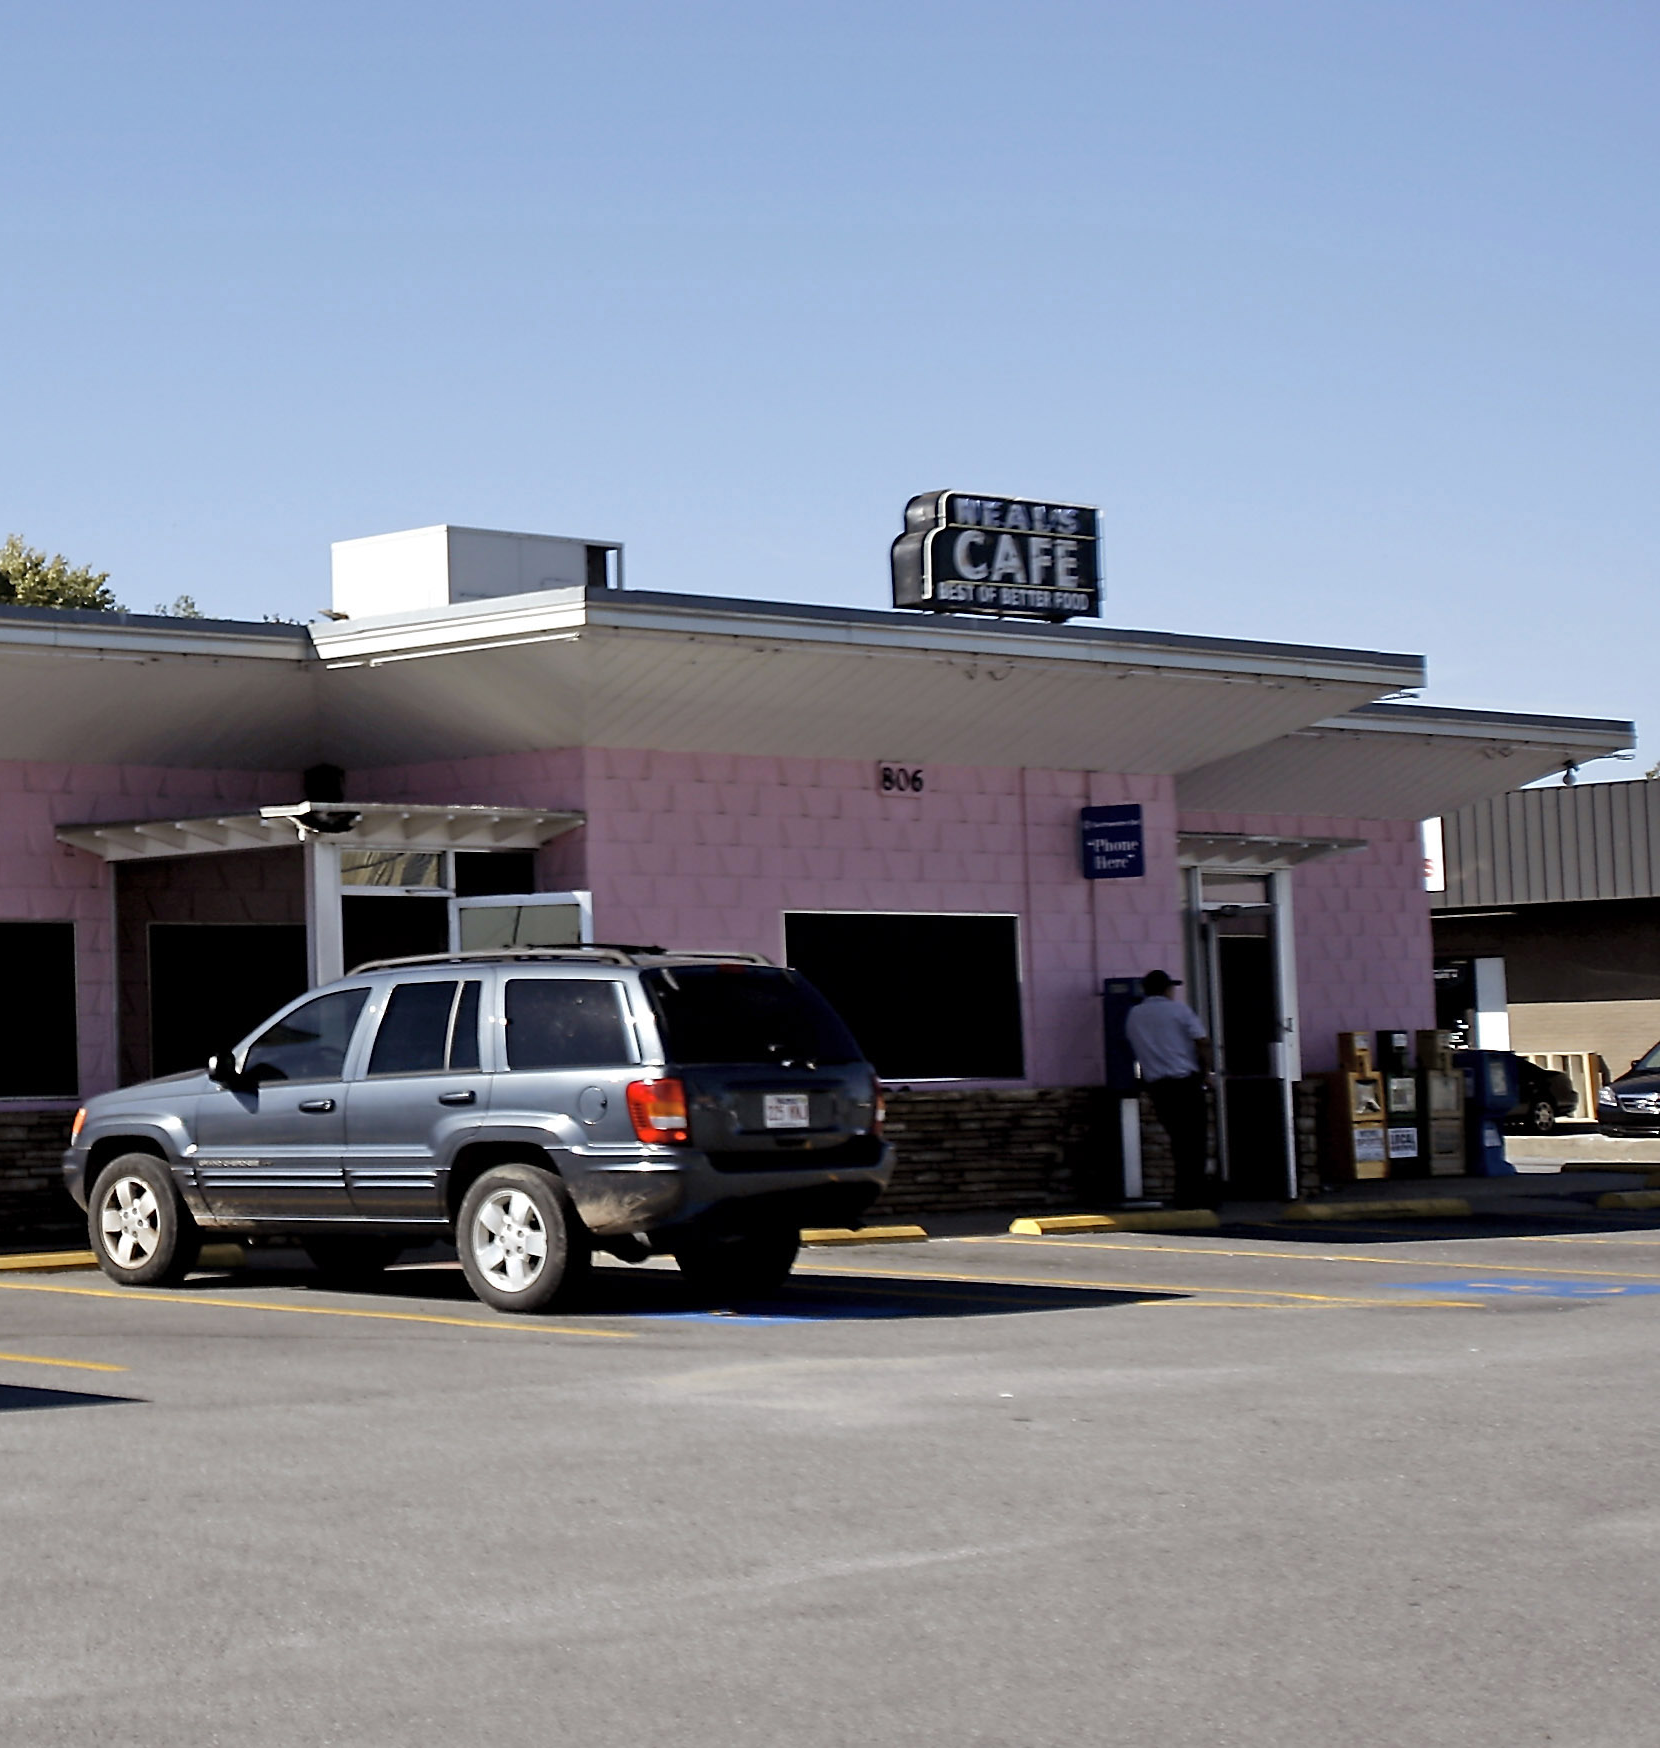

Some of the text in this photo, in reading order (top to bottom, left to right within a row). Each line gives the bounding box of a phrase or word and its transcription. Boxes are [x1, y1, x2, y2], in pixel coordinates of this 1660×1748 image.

[953, 530, 1078, 588] CAFE
[937, 582, 1090, 611] BEST OF BETTER FOOD
[882, 767, 924, 792] 806
